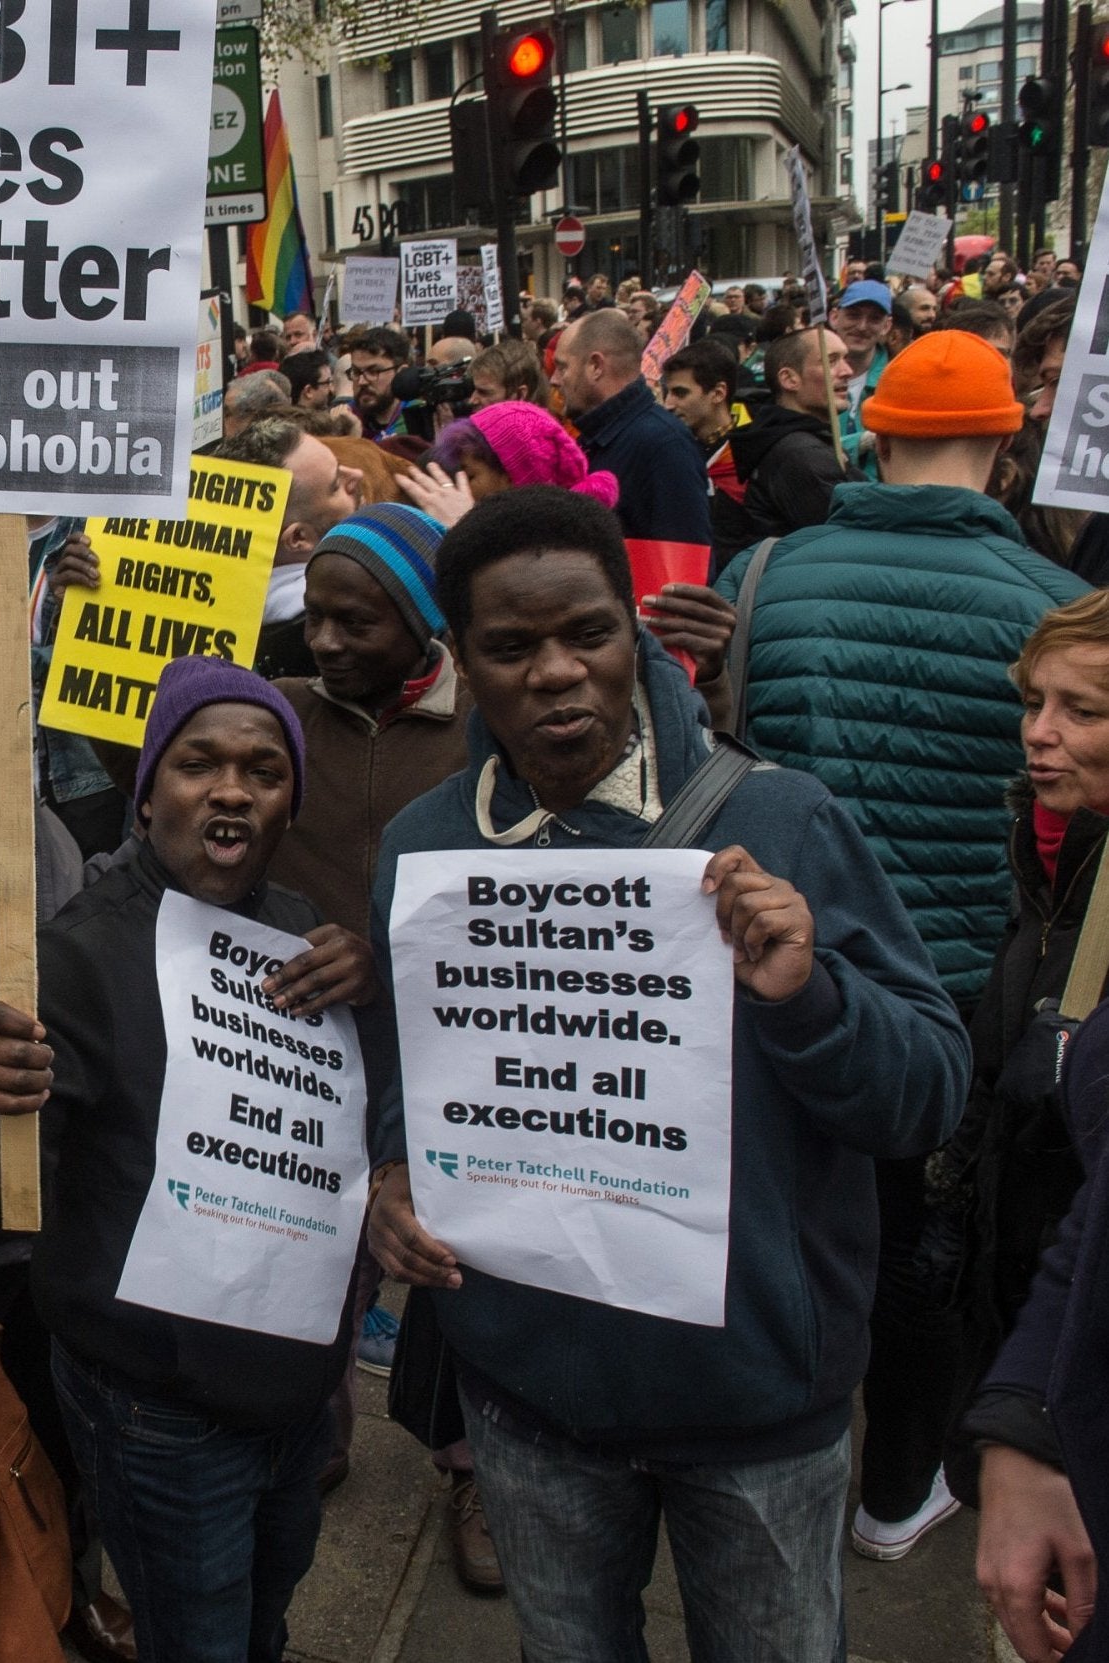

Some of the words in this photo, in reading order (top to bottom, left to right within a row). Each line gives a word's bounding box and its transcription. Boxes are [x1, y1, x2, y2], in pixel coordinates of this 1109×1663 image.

[220, 5, 241, 17] pm
[217, 42, 248, 57] low
[210, 111, 239, 130] EZ
[207, 164, 246, 184] NE
[218, 203, 254, 217] times
[352, 205, 374, 241] 45
[405, 250, 453, 268] LGBT+
[405, 269, 442, 284] Lives
[405, 284, 453, 299] Matter
[24, 359, 120, 411] out
[154, 519, 253, 559] HUMAN
[115, 557, 215, 608] RIGHTS,
[74, 602, 132, 650] ALL
[139, 614, 237, 662] LIVES
[58, 664, 157, 720] MATT
[467, 876, 651, 913] Boycott
[209, 931, 285, 978] Boyc
[435, 961, 692, 1000] businesses
[192, 994, 344, 1072] businesses
[433, 1003, 681, 1046] worldwide.
[191, 1036, 343, 1105] worldwide.
[494, 1056, 577, 1092] End
[592, 1065, 646, 1100] all
[229, 1093, 283, 1135] End
[291, 1115, 324, 1148] all
[443, 1101, 688, 1152] executions
[186, 1130, 342, 1194] executions
[467, 1155, 512, 1172] Peter
[516, 1160, 585, 1182] Tatchell
[590, 1170, 690, 1199] Foundation
[467, 1172, 518, 1188] Speaking
[521, 1179, 539, 1189] out
[542, 1180, 558, 1192] for
[561, 1183, 600, 1199] Human
[604, 1190, 639, 1207] Rights
[193, 1204, 229, 1223] Speaking
[229, 1214, 244, 1225] out
[245, 1217, 258, 1229] for
[258, 1221, 285, 1236] Human
[286, 1227, 309, 1242] Rights
[195, 1186, 228, 1207] Peter
[231, 1196, 277, 1220] Tatchell
[279, 1209, 337, 1236] Foundation
